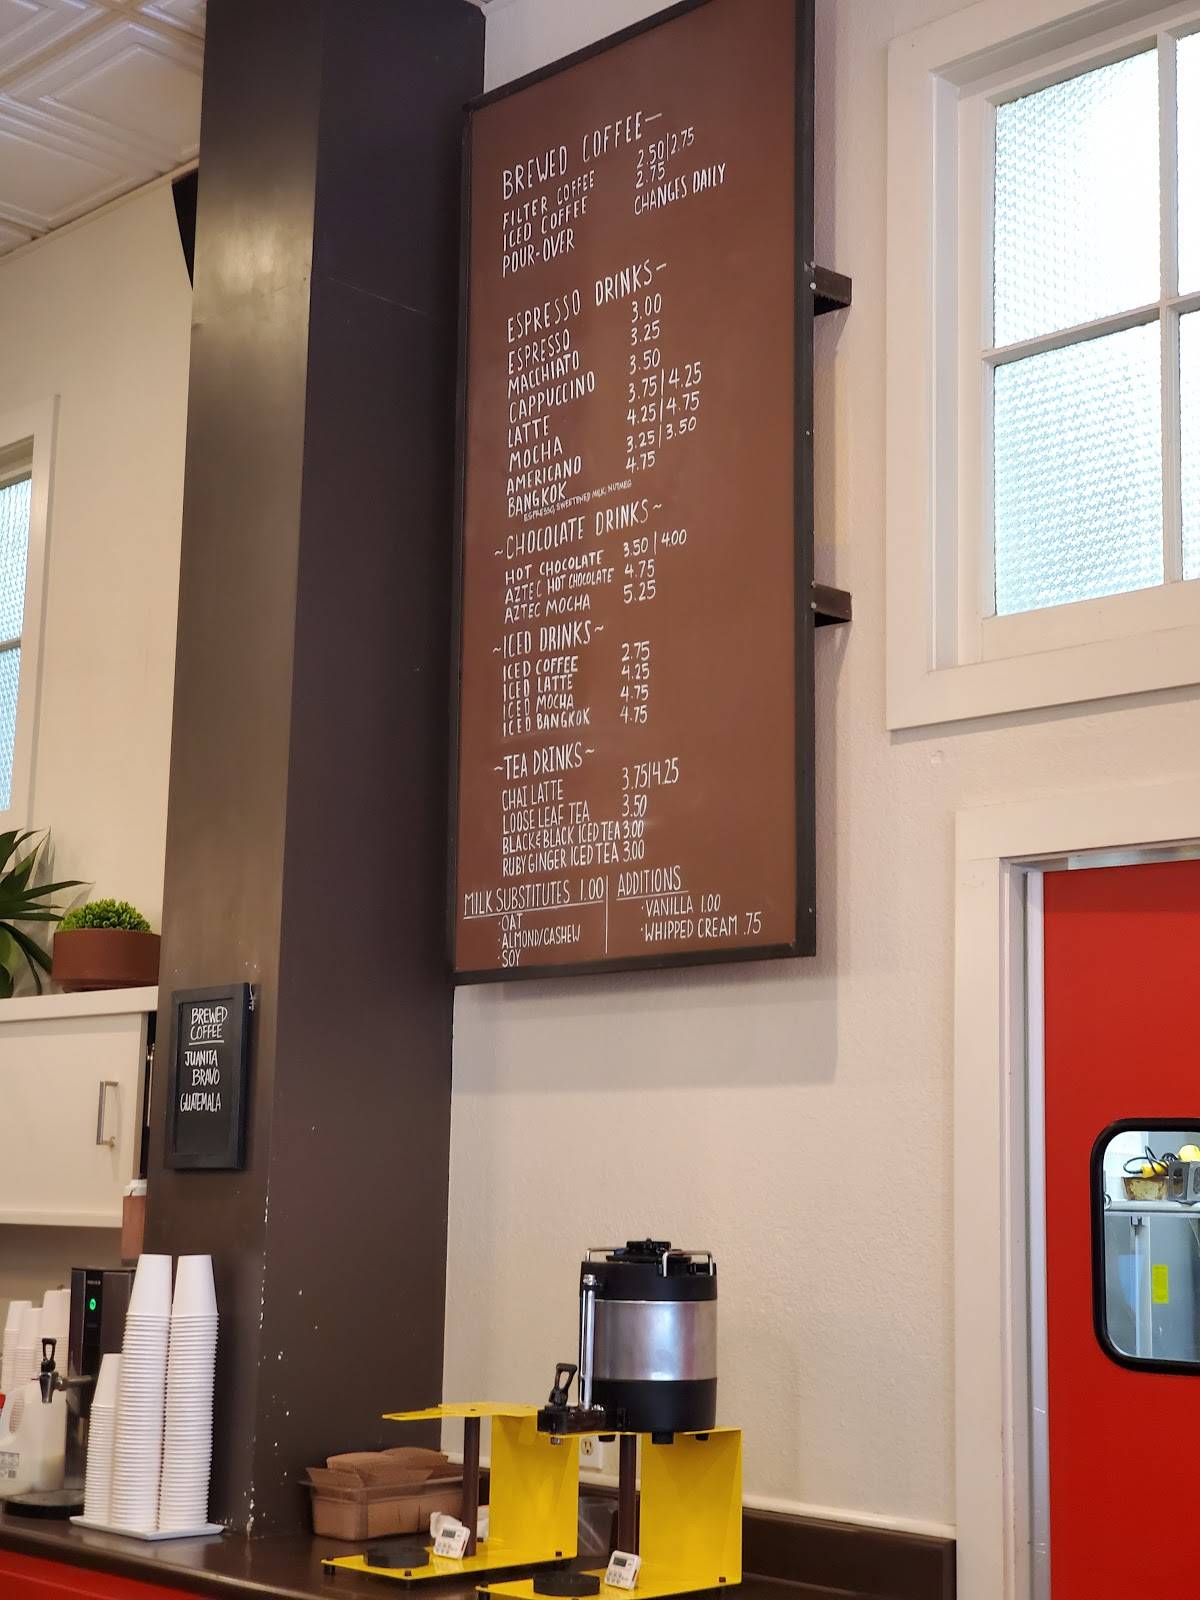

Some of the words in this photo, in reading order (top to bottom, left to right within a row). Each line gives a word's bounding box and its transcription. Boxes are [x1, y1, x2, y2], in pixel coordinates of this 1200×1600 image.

[503, 146, 567, 200] BREWED
[635, 161, 666, 189] 2.75
[503, 196, 547, 230] FILTER
[557, 170, 595, 205] COFFEE
[634, 175, 687, 216] CHANGES
[693, 163, 726, 194] DAILY
[503, 223, 532, 252] ICED
[541, 196, 588, 235] COFFEE
[503, 228, 575, 278] POUR-OVER
[507, 289, 581, 344] ESPRESSO
[632, 293, 662, 323] 3.00
[631, 320, 660, 346] 3.25
[508, 328, 570, 375] ESPRESSO
[630, 348, 661, 375] 3.50
[507, 350, 579, 399] MACCHIATO
[509, 370, 595, 424] CAPPUCCINO
[508, 415, 550, 449] LATTE
[509, 435, 563, 473] MOCHA
[626, 451, 656, 474] 4.75
[506, 455, 582, 496] AMERICANO
[508, 481, 567, 518] BANGKOK
[623, 537, 649, 558] 3.50
[505, 564, 533, 585] HOT
[539, 550, 604, 577] CHOCOLATE
[624, 558, 655, 579] 4.75
[505, 580, 542, 605] AZTEC
[547, 573, 566, 595] HOT
[568, 567, 615, 589] CHOCOLATE
[623, 579, 657, 604] 5.25
[504, 602, 541, 624] AZTEC
[545, 593, 591, 617] MOCHA
[621, 641, 650, 662] 2.75
[503, 660, 531, 681] ICED
[536, 655, 579, 675] COFFEE
[621, 662, 650, 681] 4.25
[503, 679, 530, 702] ICED
[537, 673, 573, 693] LATTE
[620, 684, 649, 703] 4.75
[503, 697, 530, 721] ICED
[536, 693, 574, 712] MOCHA
[619, 705, 648, 725] 4.75
[503, 716, 531, 737] ICED
[536, 707, 591, 731] BANGKOK
[502, 785, 528, 812] CHAI
[531, 779, 564, 805] LATTE
[622, 794, 647, 818] 3.50
[502, 808, 535, 835] LOOSE
[538, 804, 564, 828] LEAF
[568, 800, 590, 824] TEA
[578, 821, 599, 844] ICED
[600, 821, 621, 841] TEA
[622, 819, 645, 840] 3.00
[502, 854, 527, 878] RUBY
[528, 848, 567, 874] GINGER
[570, 843, 593, 867] ICED
[595, 842, 619, 865] TEA
[622, 839, 645, 863] 3.00
[617, 864, 681, 897] ADDITIONS
[464, 890, 493, 916] MILK
[496, 879, 570, 913] SUBSTITUTES
[580, 876, 604, 901] 1.00
[701, 893, 721, 913] 1.00
[697, 914, 738, 938] CREAM
[743, 911, 762, 935] .75
[191, 1006, 228, 1025] BREWED
[190, 1023, 223, 1041] COFFEE
[184, 1049, 218, 1067] JUANITA
[191, 1068, 220, 1087] BRAVO
[180, 1092, 221, 1113] GUATEMALA
